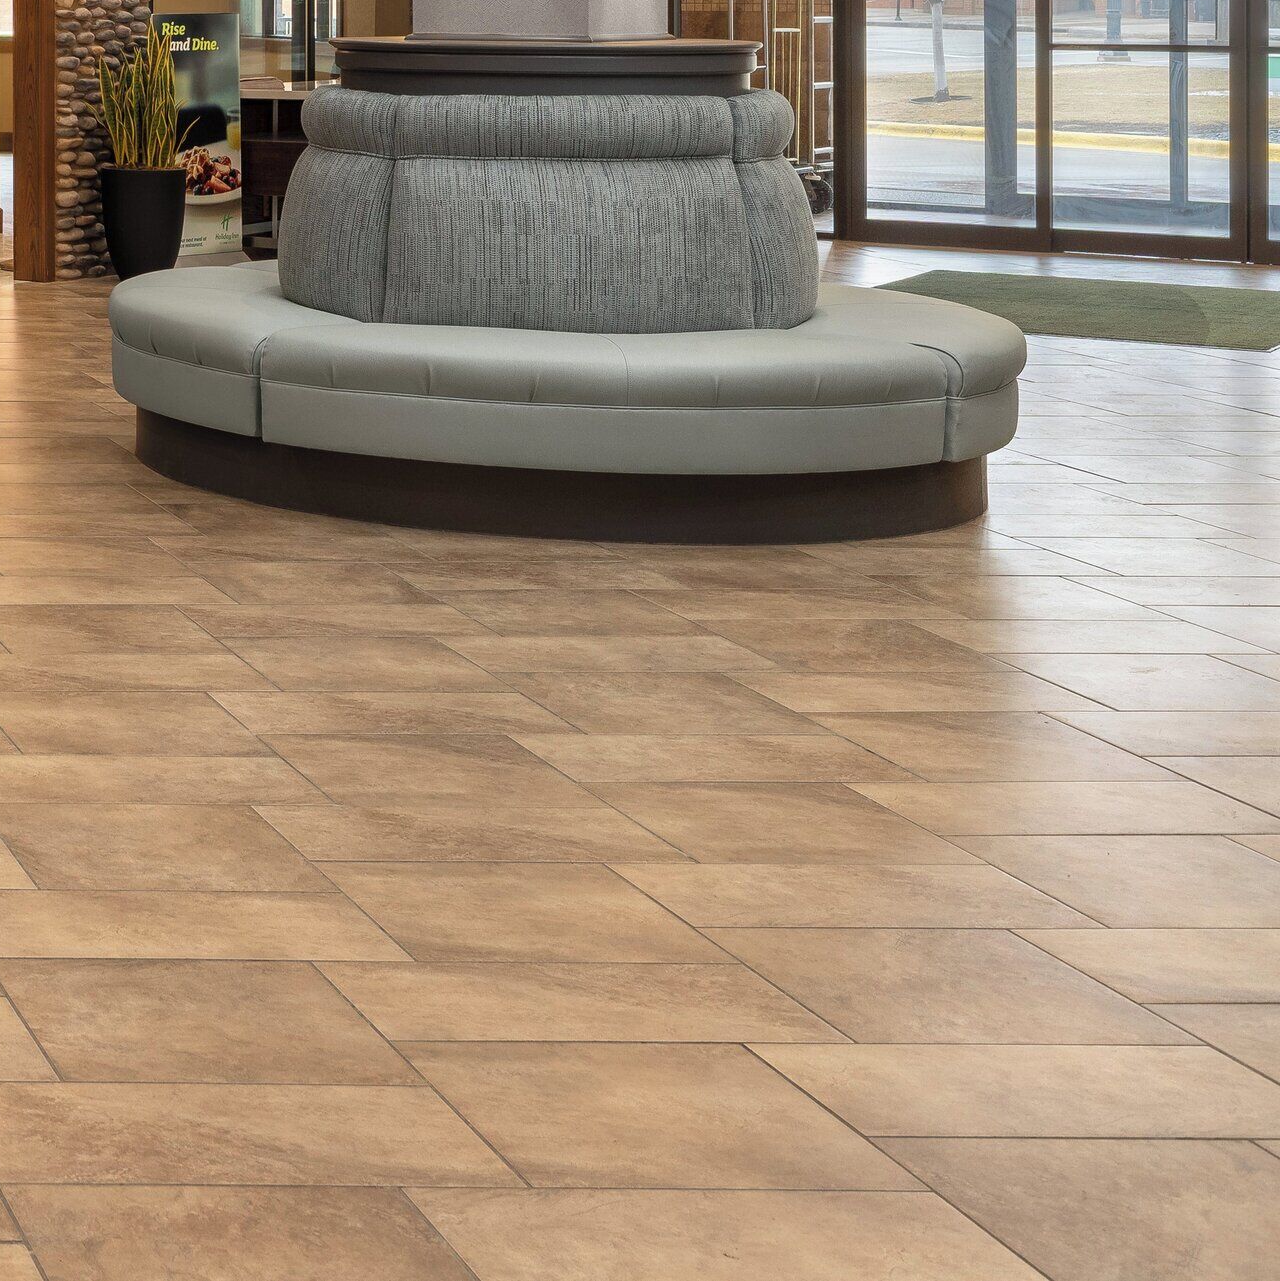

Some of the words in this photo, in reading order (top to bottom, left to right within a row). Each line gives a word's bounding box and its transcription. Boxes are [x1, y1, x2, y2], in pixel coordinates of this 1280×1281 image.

[161, 22, 186, 36] Rise
[170, 37, 191, 51] and
[192, 36, 220, 51] Dine.
